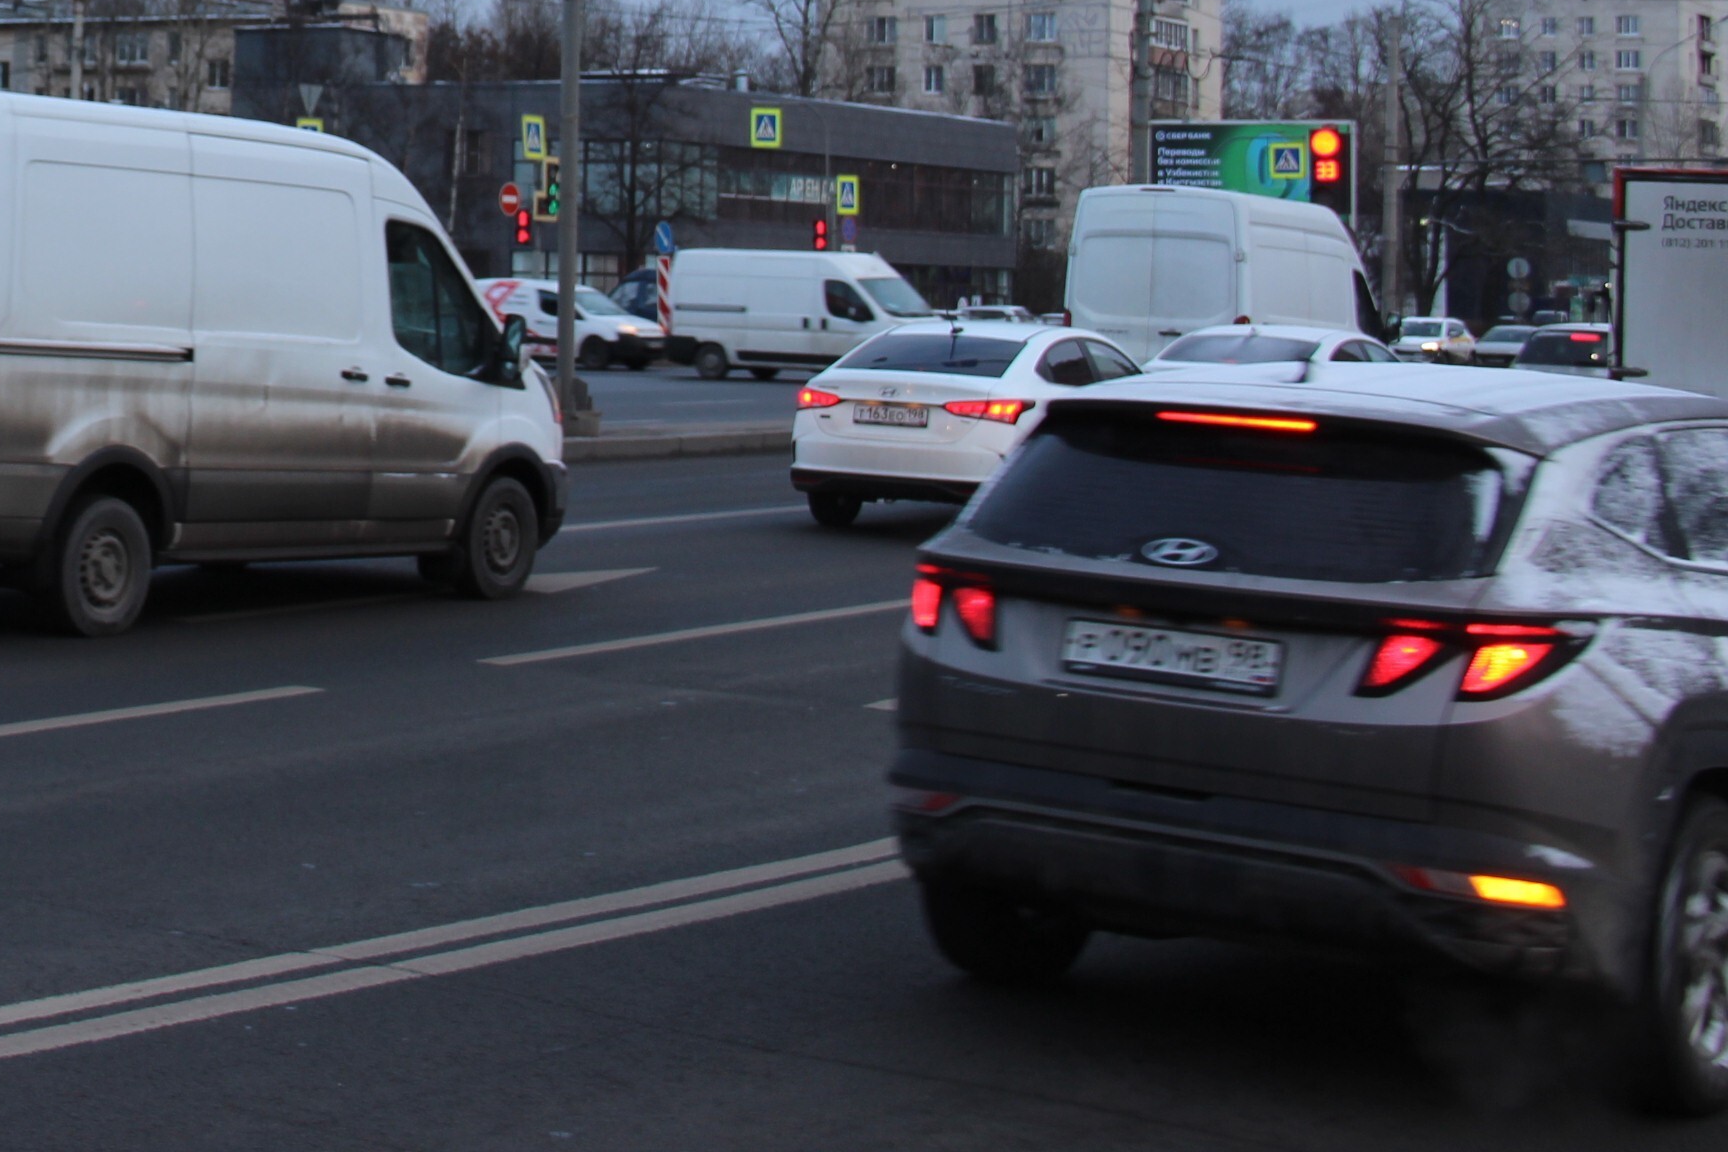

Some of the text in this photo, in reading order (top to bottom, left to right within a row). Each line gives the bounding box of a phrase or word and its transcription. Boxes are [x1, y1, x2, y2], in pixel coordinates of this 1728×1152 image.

[1157, 147, 1205, 157] Переводы
[1157, 156, 1221, 166] без комиссии
[1165, 168, 1219, 177] Узбекистан
[1663, 195, 1728, 213] Яндекс
[1661, 213, 1728, 231] Достав
[1661, 238, 1690, 248] (812)
[1694, 239, 1715, 248] 201
